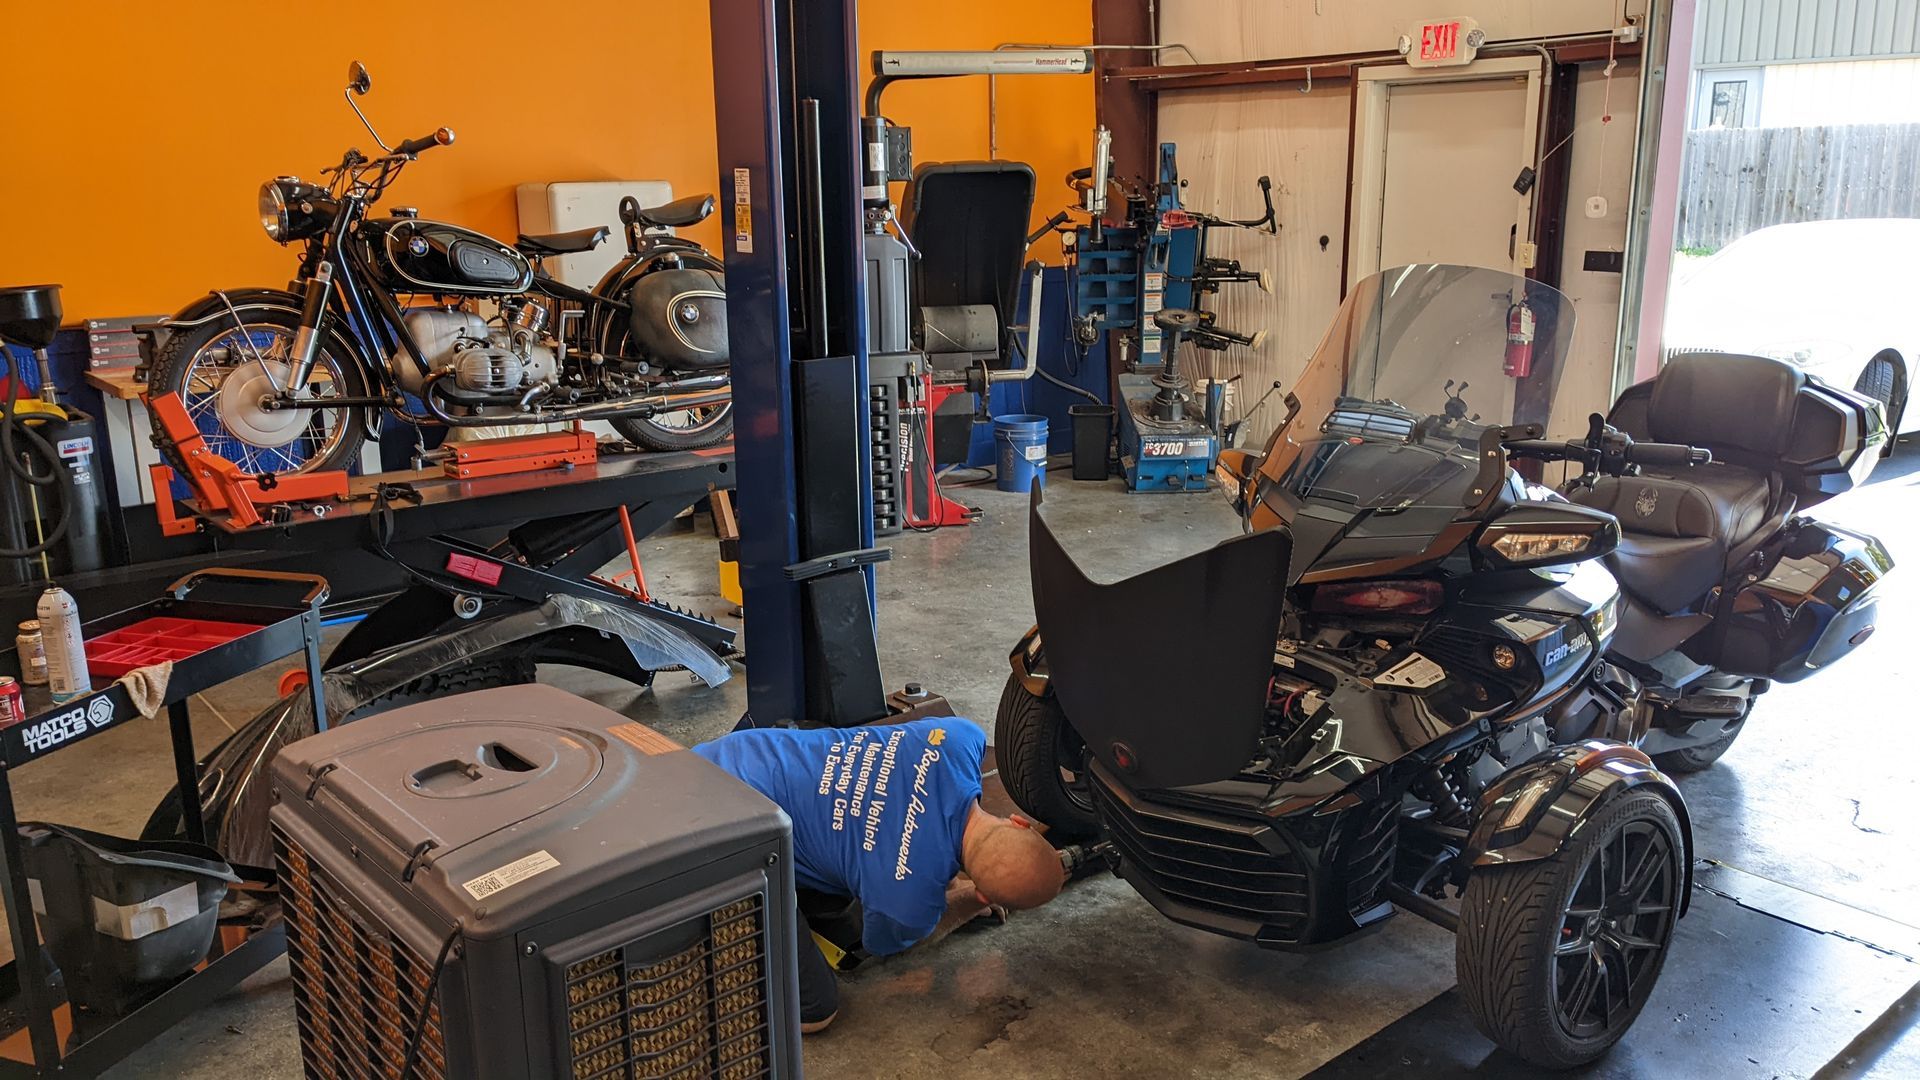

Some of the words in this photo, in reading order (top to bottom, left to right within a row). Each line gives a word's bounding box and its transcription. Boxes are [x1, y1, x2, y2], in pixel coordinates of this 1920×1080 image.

[1421, 22, 1460, 59] EXIT
[1034, 57, 1068, 66] HammerHead
[1544, 631, 1590, 667] can-am
[21, 707, 85, 742] MATCO
[24, 719, 87, 753] TOOLS
[853, 731, 869, 744] For
[830, 741, 846, 753] To
[873, 731, 905, 797] Exceptional
[818, 754, 841, 796] Exotics
[834, 744, 862, 794] Everyday
[850, 742, 882, 817] Maintenance
[913, 748, 940, 796] Royal
[832, 798, 847, 831] Cars
[862, 799, 885, 852] Vehicle
[895, 794, 925, 881] Autowerks
